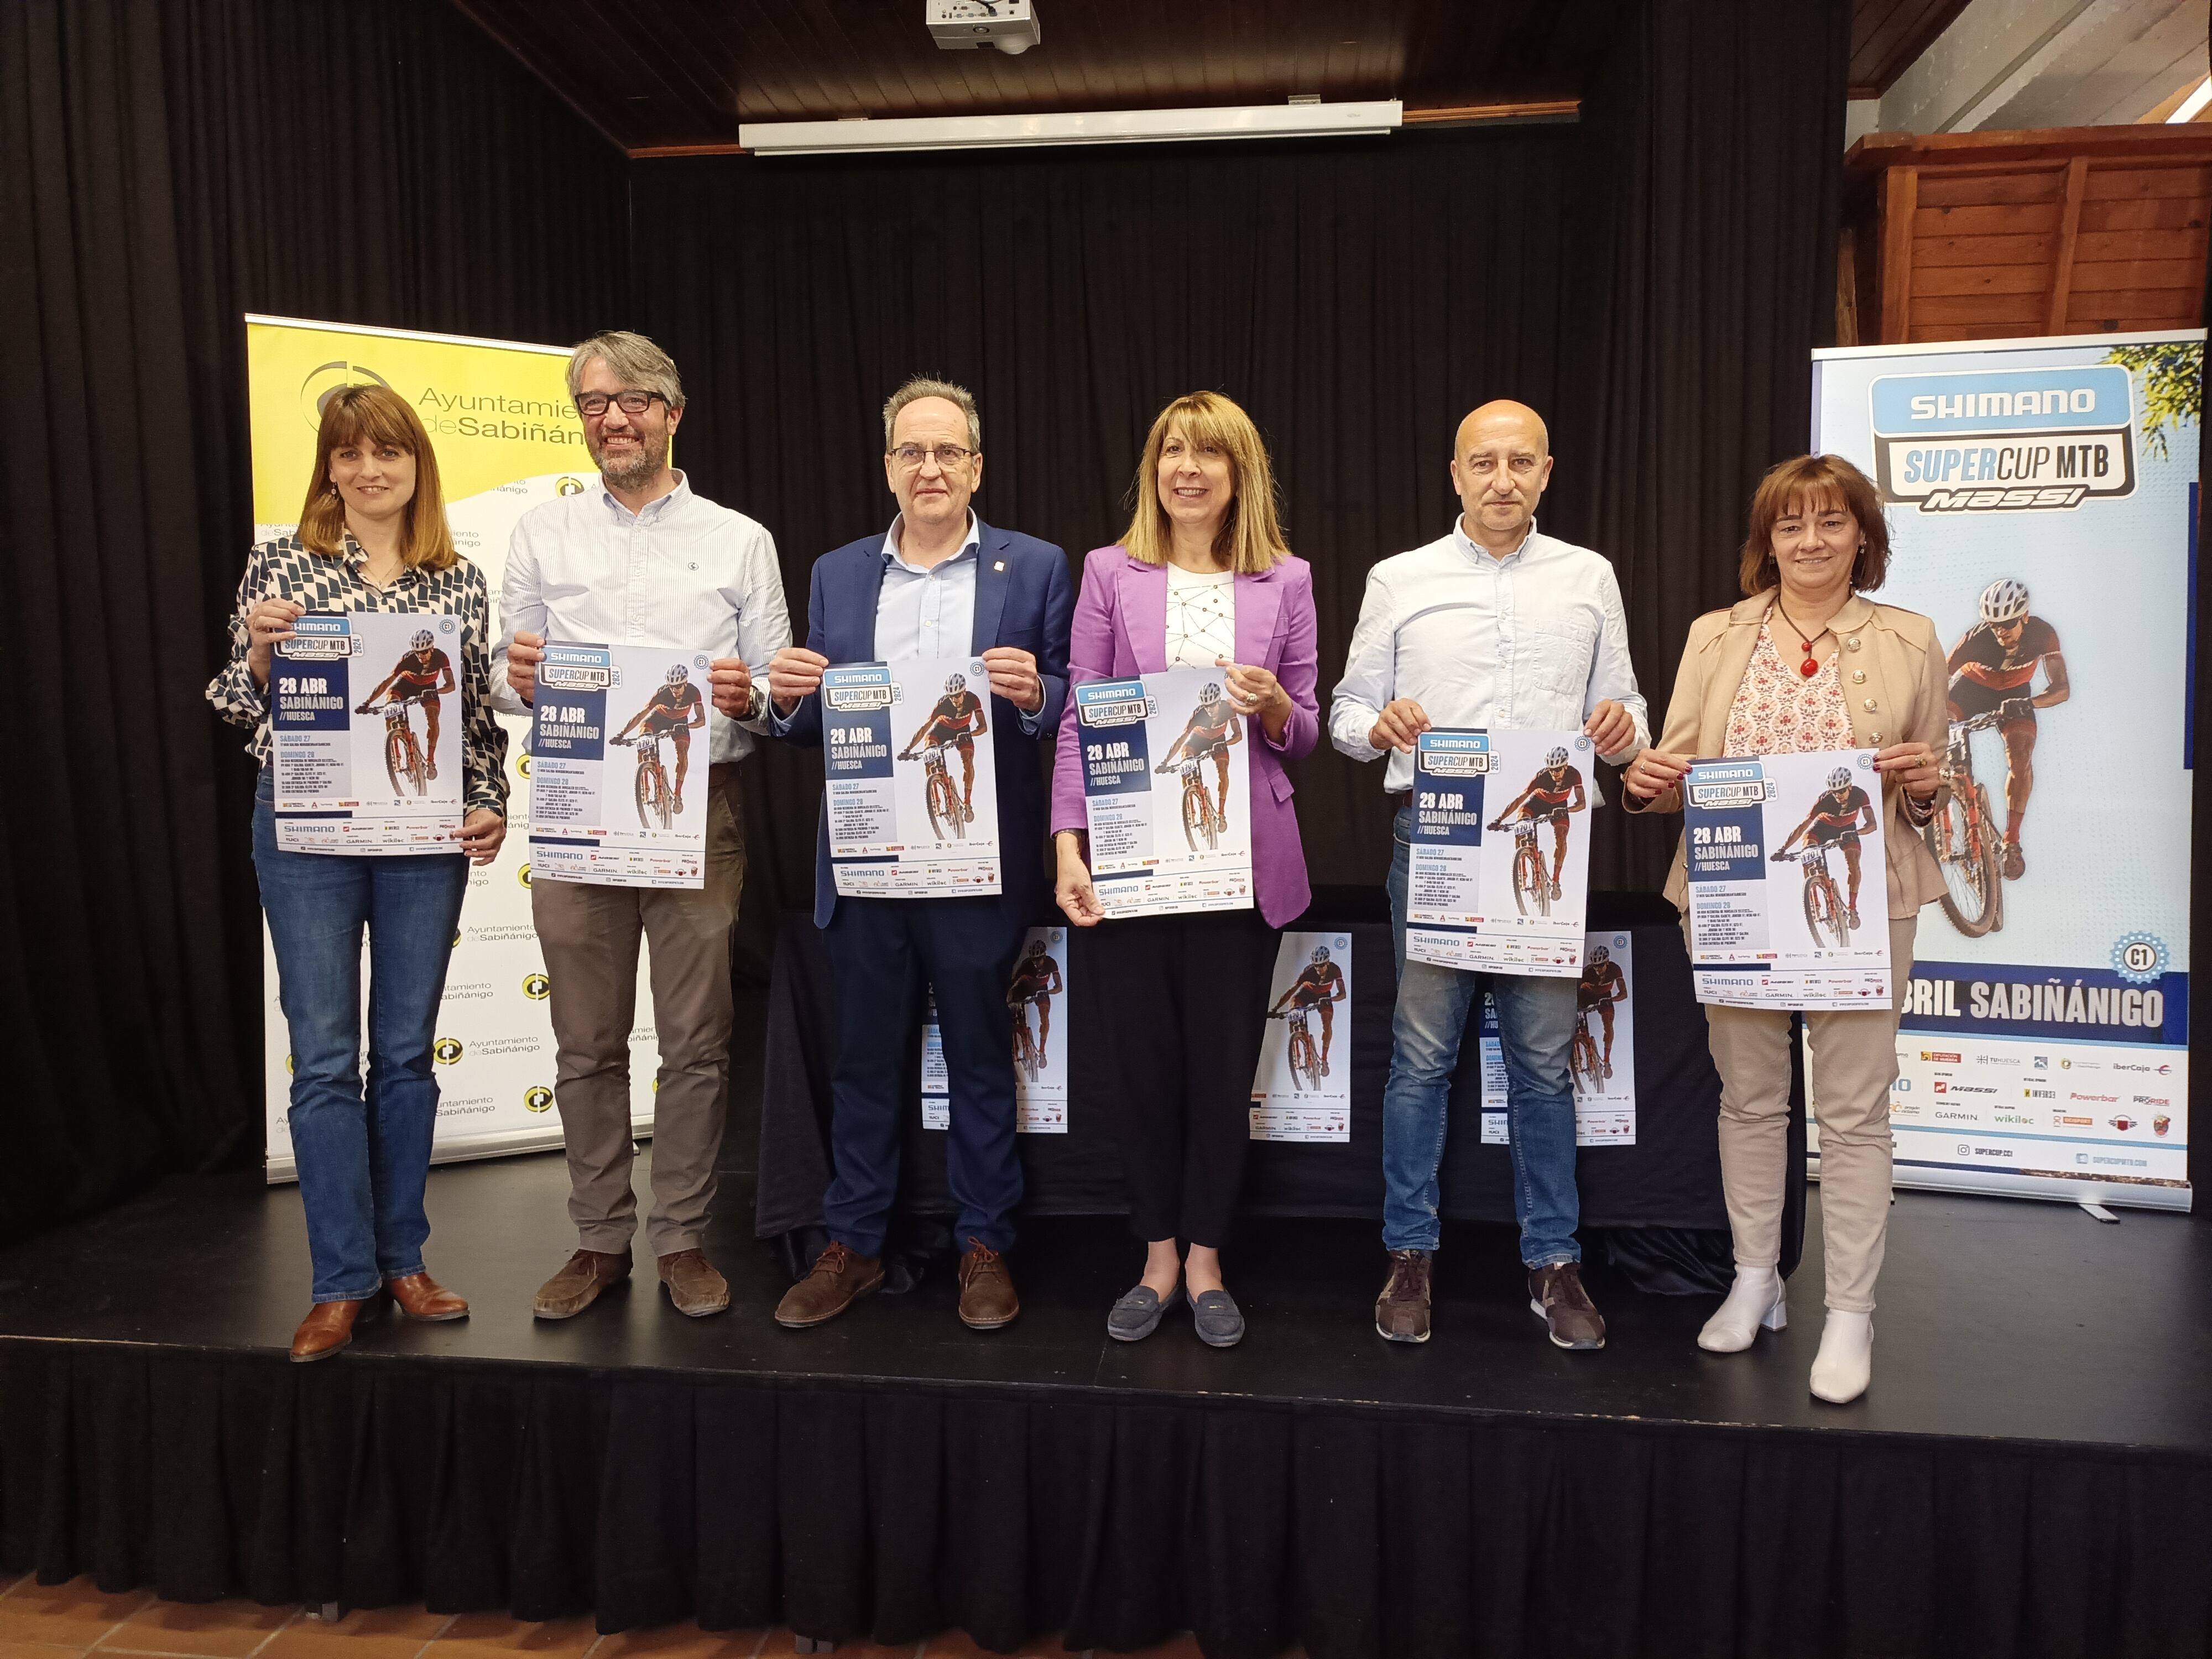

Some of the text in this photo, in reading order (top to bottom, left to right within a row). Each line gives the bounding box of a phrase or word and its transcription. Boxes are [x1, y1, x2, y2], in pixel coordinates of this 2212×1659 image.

[419, 387, 578, 419] Ayuntamie
[1911, 388, 2095, 420] SHIMANO
[421, 414, 584, 445] deSabiñán
[1904, 444, 2109, 483] SUPERCUP MTB
[285, 639, 345, 650] SUPERCUP MTB
[354, 638, 362, 653] 2024
[551, 653, 602, 663] SHIMANO
[549, 669, 604, 681] SUPERCUP MTB
[834, 674, 882, 684] SHIMANO
[279, 677, 327, 694] 28 ABR
[834, 690, 886, 701] SUPERCUP MTB
[893, 687, 902, 701] 2024
[1088, 688, 1136, 700] SHIMANO
[280, 694, 343, 709] SABIÑÁNIGO
[1147, 700, 1157, 714] 2024
[540, 705, 557, 722] 28
[560, 707, 585, 723] ABR
[1089, 703, 1141, 718] SUPERCUP MTB
[540, 722, 599, 739] SABIÑÁNIGO
[831, 727, 872, 744] 28 ABR
[1430, 739, 1480, 748] SHIMANO
[831, 743, 887, 759] SABIÑÁNIGO
[1087, 742, 1129, 761] 28 ABR
[1089, 758, 1144, 775] SABIÑÁNIGO
[1428, 755, 1483, 767] SUPERCUP MTB
[1698, 769, 1753, 780] SHIMANO
[1698, 786, 1759, 799] SUPERCUP MTB
[1766, 782, 1776, 798] 2024
[1419, 792, 1463, 810] 28 ABR
[1418, 809, 1477, 826] SABIÑÁNIGO
[1693, 826, 1741, 844] 28 ABR
[536, 851, 583, 860] SHIMANO
[1416, 847, 1436, 855] SÁBADO
[1694, 843, 1759, 860] SABIÑÁNIGO
[1099, 885, 1139, 896] SHIMANO
[1413, 936, 1460, 946] SHIMANO
[2131, 948, 2148, 966] C1
[441, 991, 494, 1000] abiñánigo
[1901, 978, 2164, 1028] BRIL SABIÑÁNIGO
[469, 1036, 539, 1048] Ayuntamiento
[469, 1045, 540, 1056] deSabiñánigo
[439, 1097, 494, 1108] untamiento
[435, 1105, 495, 1117] Sabiñánigo
[1935, 1112, 1978, 1120] GARMIN
[1994, 1115, 2034, 1124] wikiloc
